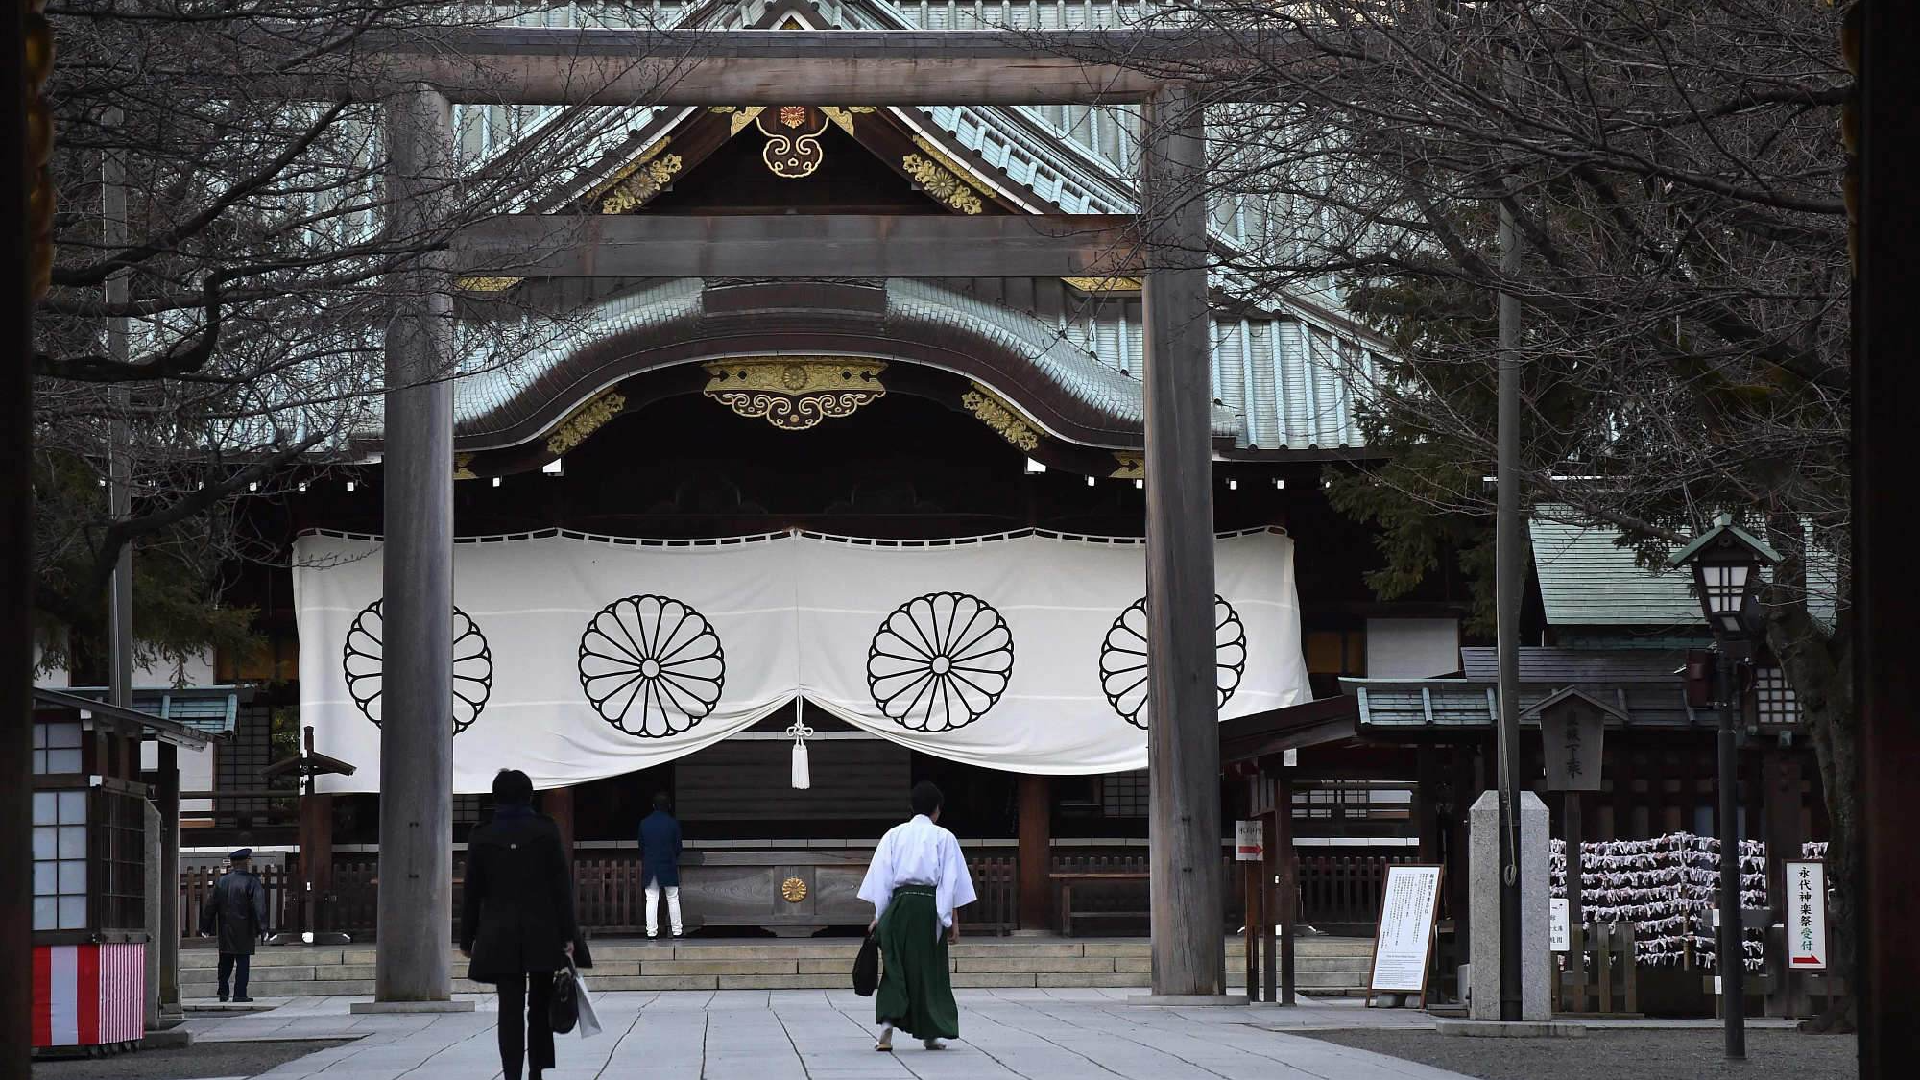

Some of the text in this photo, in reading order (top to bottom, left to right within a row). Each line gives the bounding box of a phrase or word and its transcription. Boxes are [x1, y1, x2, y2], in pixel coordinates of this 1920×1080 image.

[1798, 866, 1813, 951] 永代神楽祭受付
